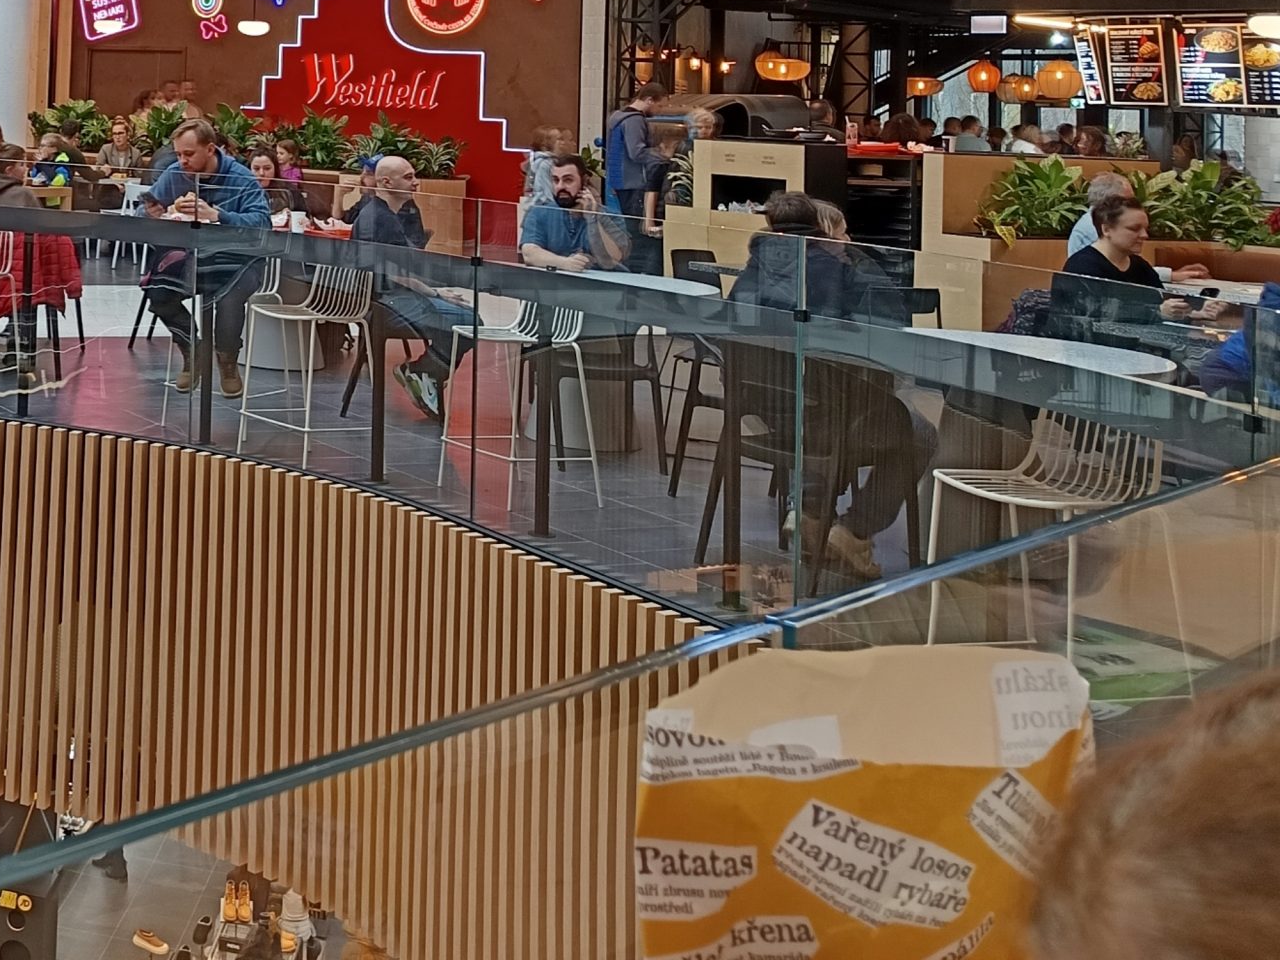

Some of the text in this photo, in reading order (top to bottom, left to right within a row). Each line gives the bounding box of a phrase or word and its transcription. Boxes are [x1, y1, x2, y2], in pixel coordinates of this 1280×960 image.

[301, 53, 446, 109] Westfield
[636, 846, 753, 878] Patatas
[811, 803, 973, 882] Vařený losos
[786, 831, 967, 914] napadl rybáře
[730, 917, 816, 948] křena
